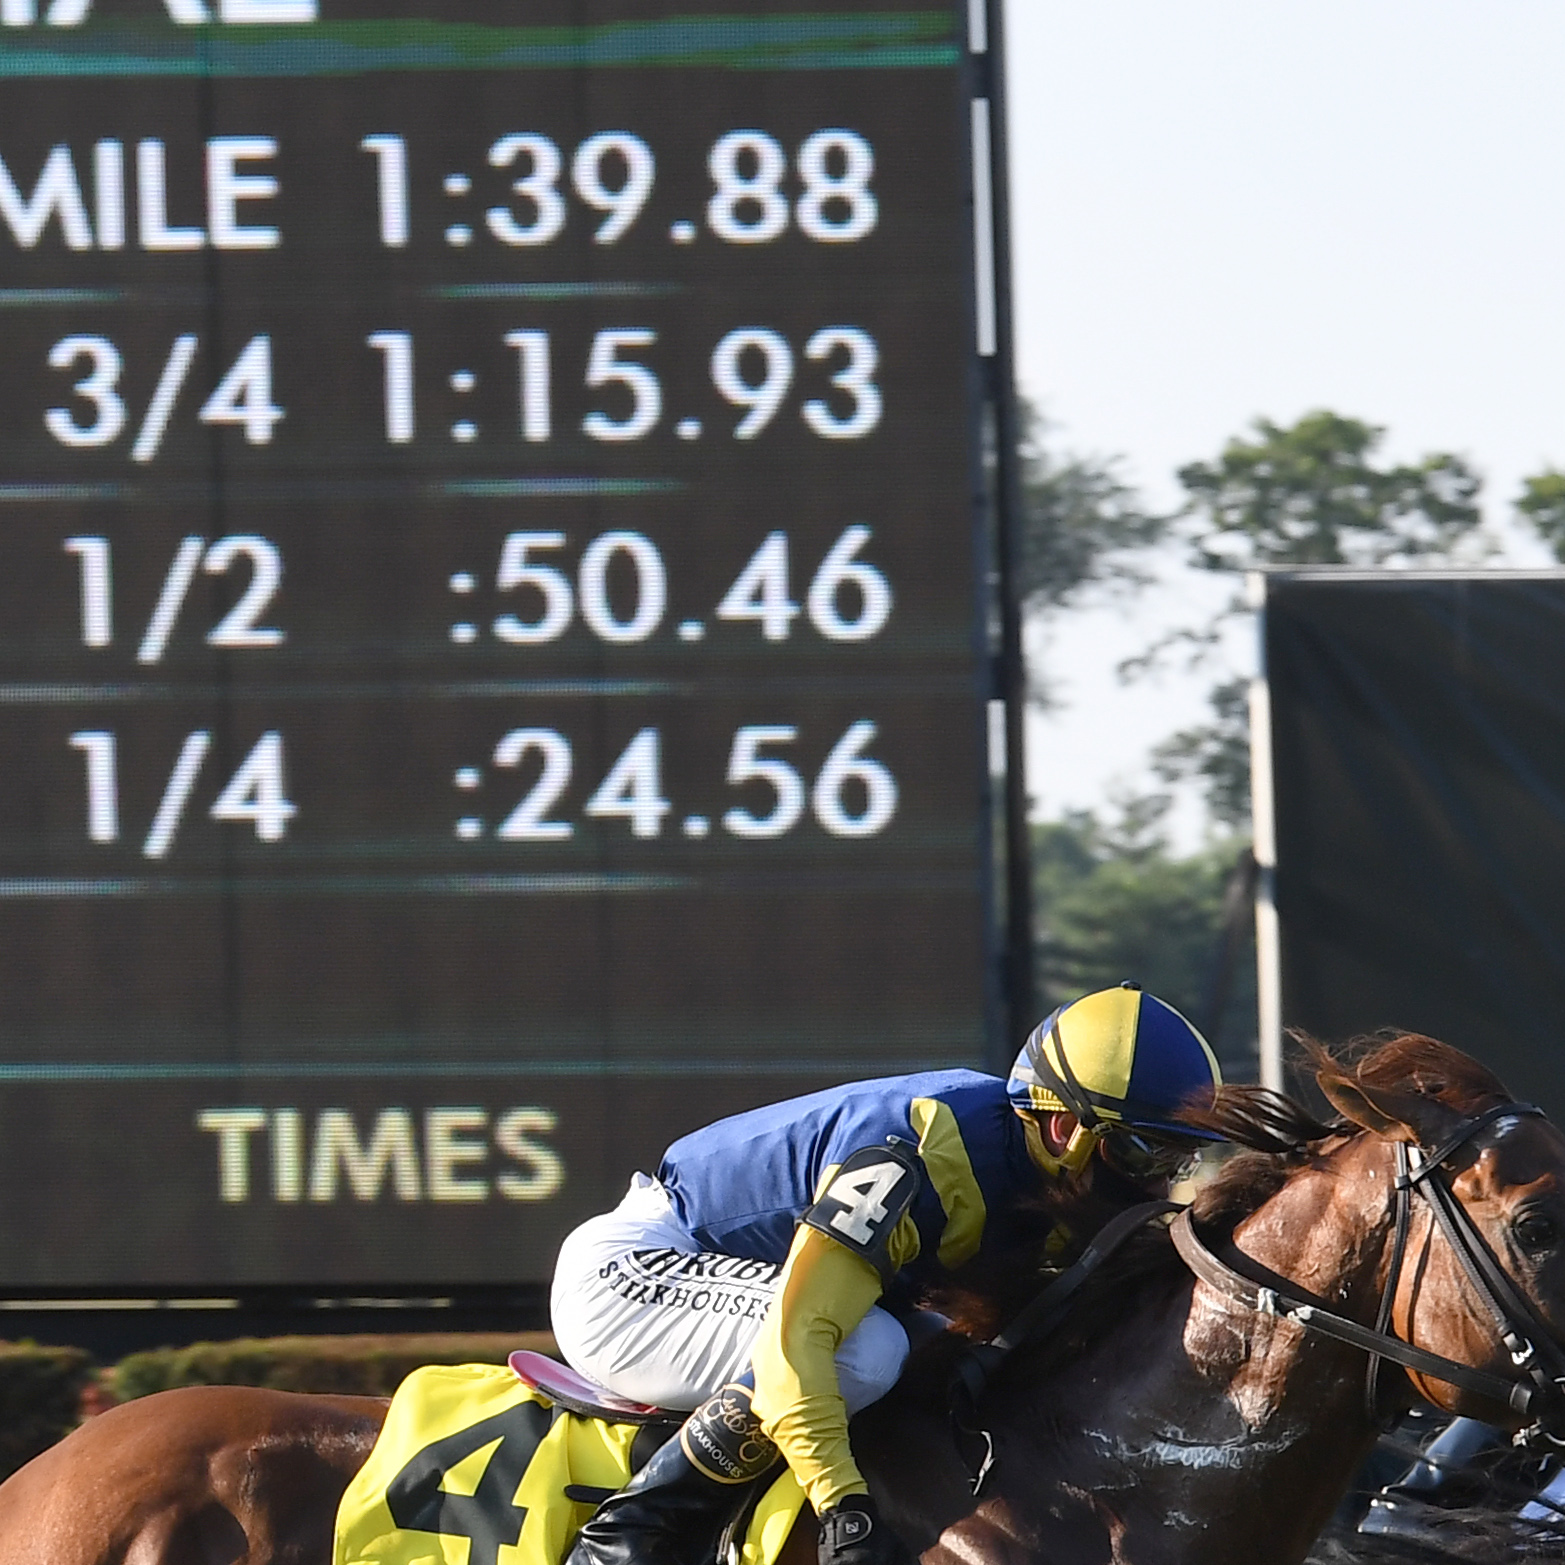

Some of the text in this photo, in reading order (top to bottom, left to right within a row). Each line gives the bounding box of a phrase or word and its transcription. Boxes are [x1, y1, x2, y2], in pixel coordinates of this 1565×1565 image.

[0, 131, 879, 250] MILE 1:39.88
[44, 327, 883, 462] 3/4 1:15.93
[64, 526, 893, 663] 1/2 :50.46
[68, 722, 898, 859] 1/4 :24.56
[198, 1106, 566, 1201] TIMES
[826, 1160, 906, 1246] 4
[687, 1418, 743, 1479] STEAKHOUSES
